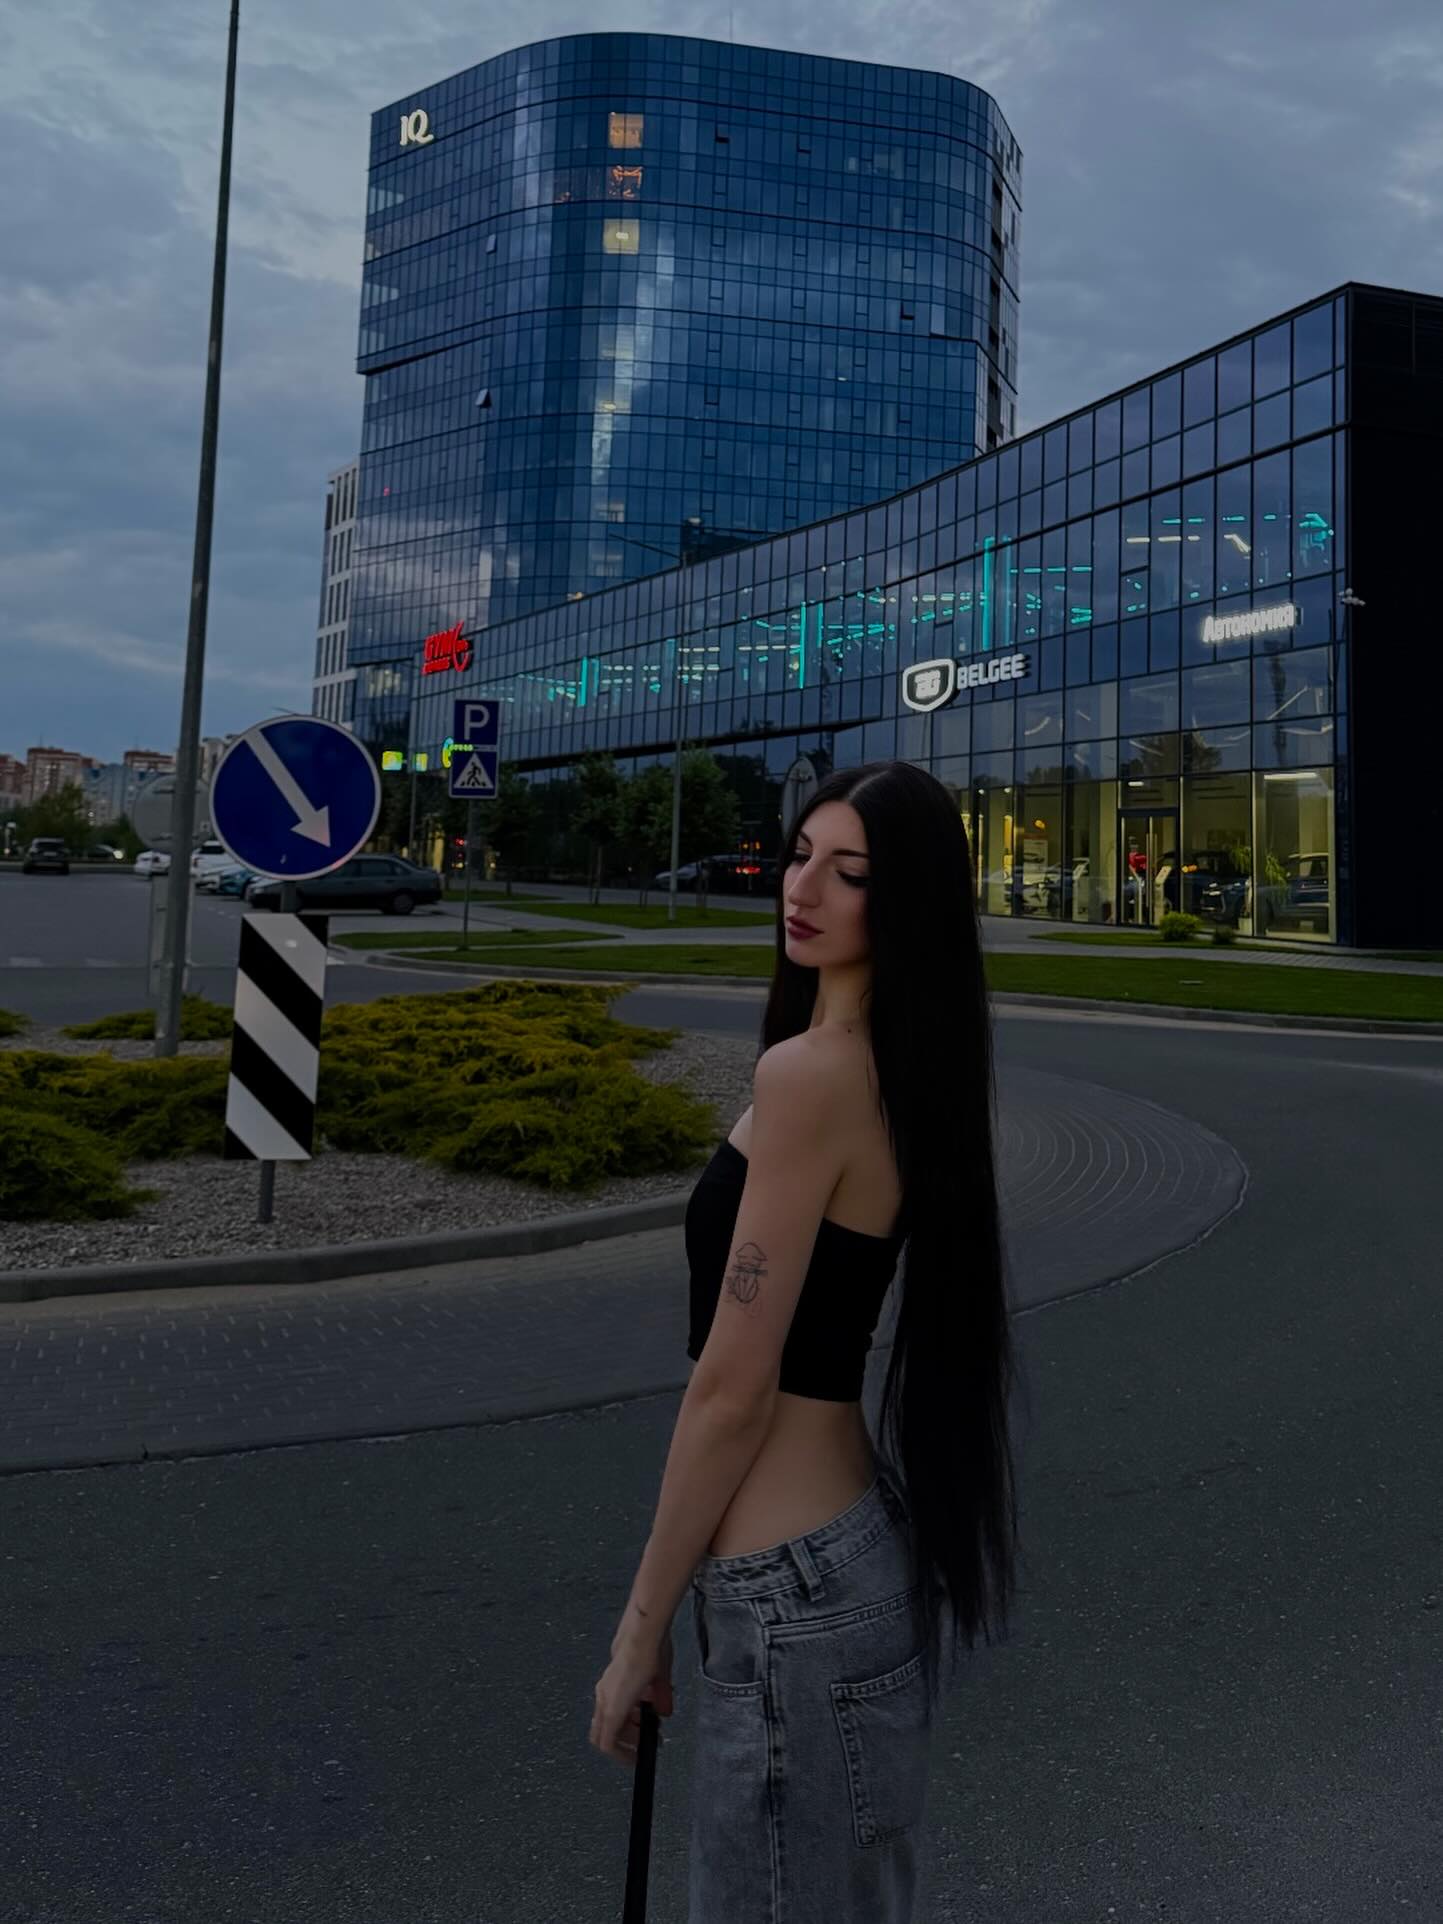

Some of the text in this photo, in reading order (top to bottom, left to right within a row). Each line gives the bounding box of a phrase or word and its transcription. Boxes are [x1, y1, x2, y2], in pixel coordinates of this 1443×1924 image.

[400, 109, 434, 146] IQ
[957, 653, 1025, 690] BELGEE
[463, 704, 490, 741] P
